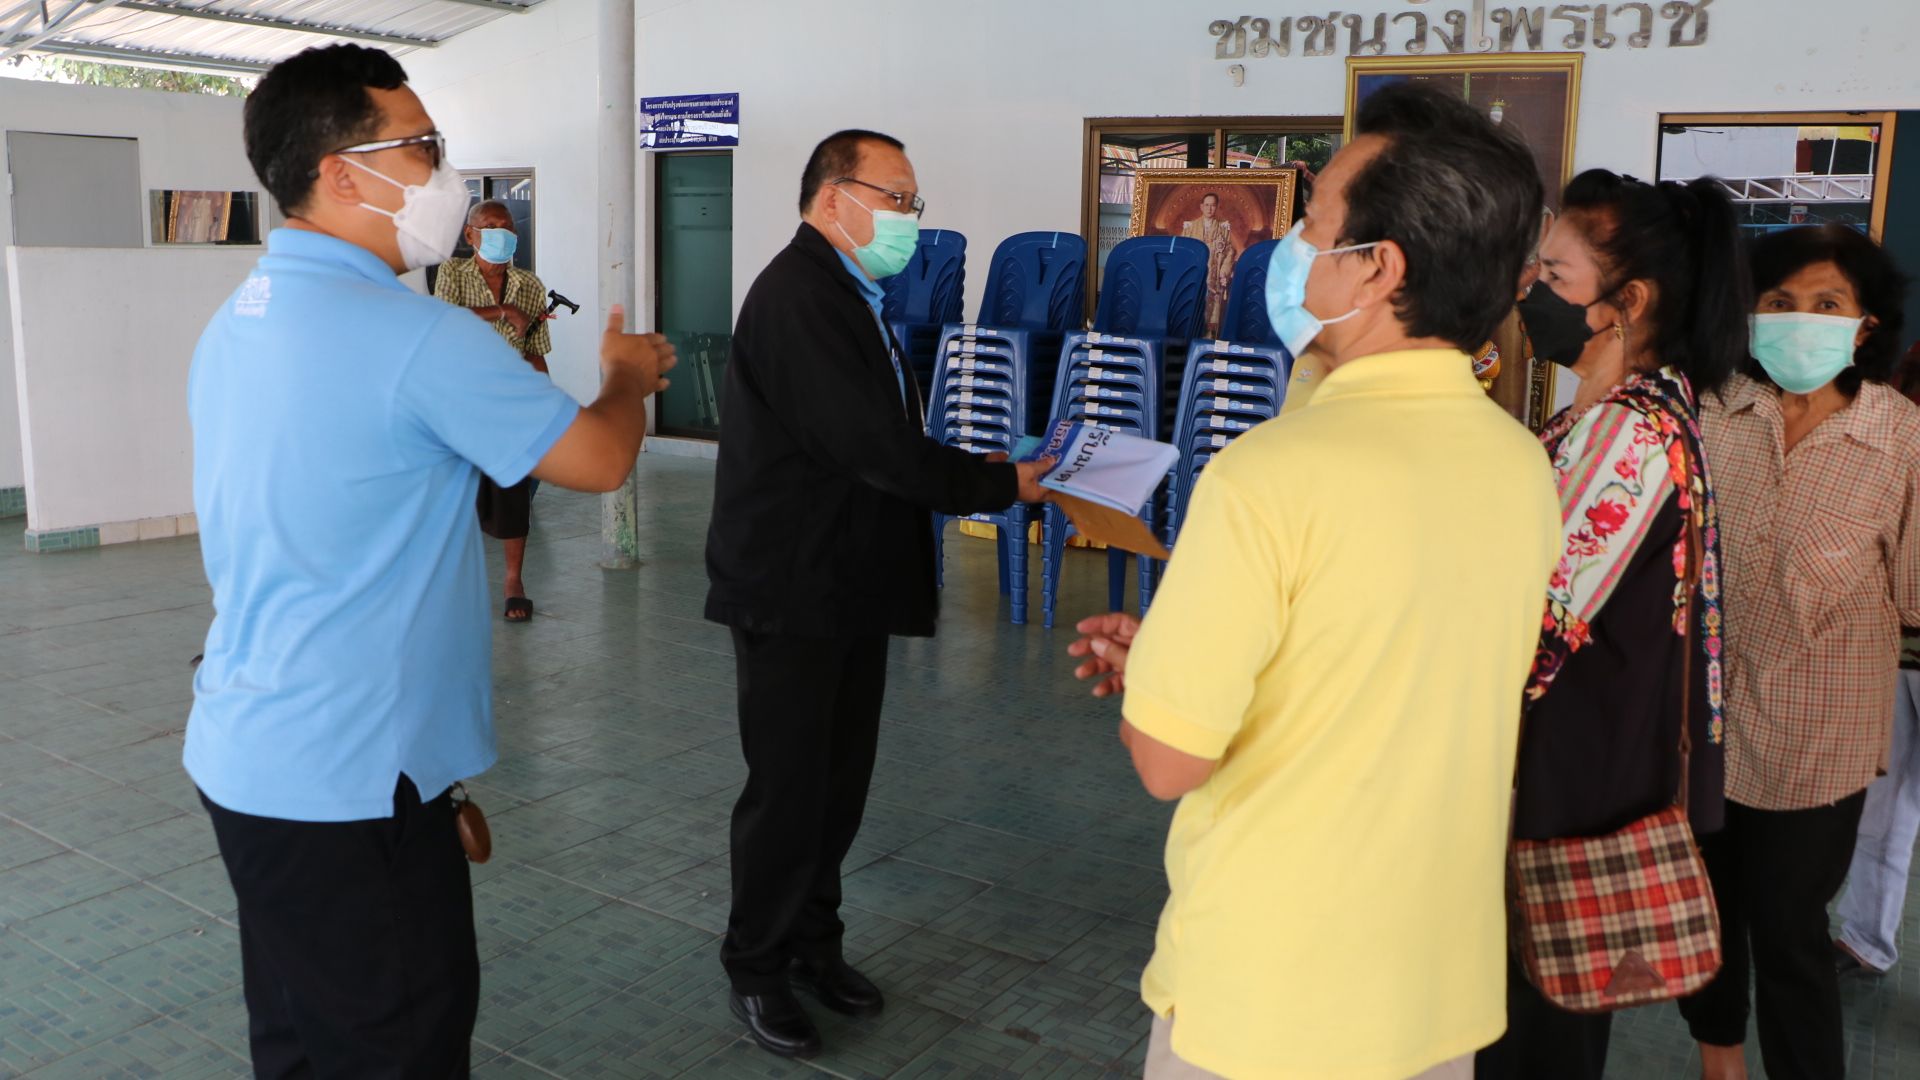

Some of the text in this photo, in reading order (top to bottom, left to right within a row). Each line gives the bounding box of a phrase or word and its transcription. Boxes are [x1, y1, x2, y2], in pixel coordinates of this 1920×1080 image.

[1208, 0, 1714, 87] ชุมชนวงไพรเวช
